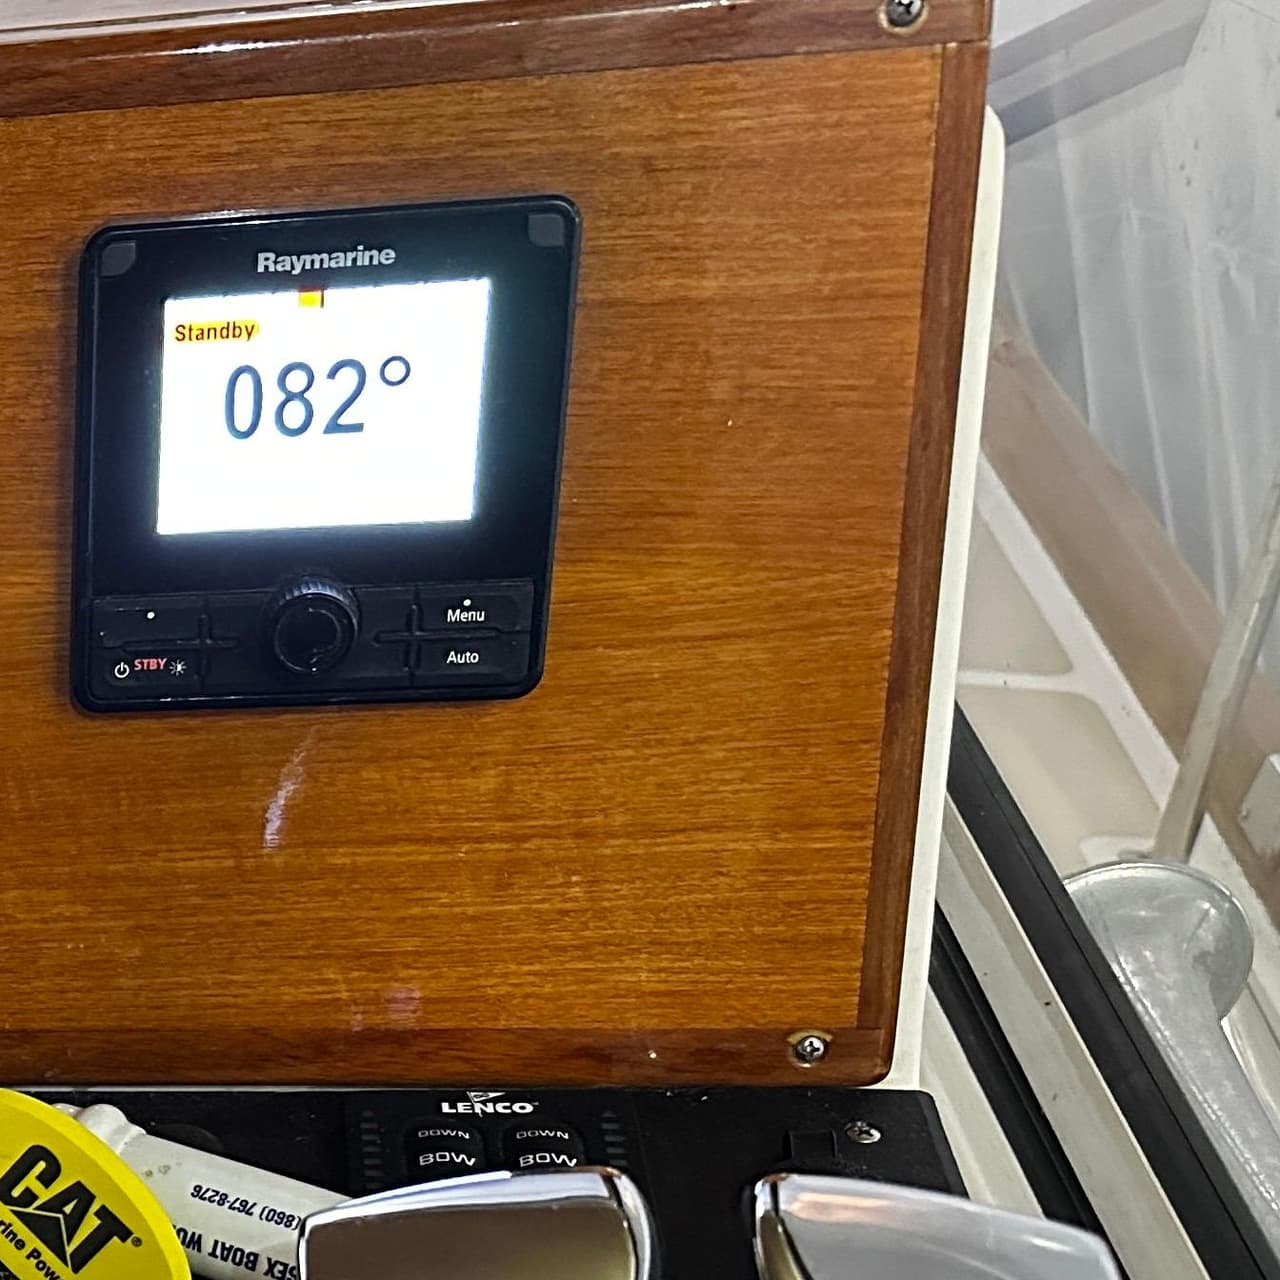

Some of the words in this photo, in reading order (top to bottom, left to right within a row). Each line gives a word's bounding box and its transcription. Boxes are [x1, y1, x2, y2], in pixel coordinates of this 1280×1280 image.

[257, 245, 396, 275] Raymarine
[174, 321, 256, 342] Standby
[447, 607, 485, 622] Menu
[133, 658, 167, 672] STBY
[447, 650, 479, 665] Auto
[441, 1102, 534, 1115] LENCO
[418, 1129, 470, 1140] DOWN
[516, 1129, 569, 1140] DOWN
[419, 1152, 476, 1167] BOW
[519, 1152, 577, 1168] BOW
[190, 1184, 258, 1217] 767-8276
[258, 1206, 301, 1231] (860)
[173, 1223, 203, 1254] WO
[207, 1239, 260, 1272] BOAT
